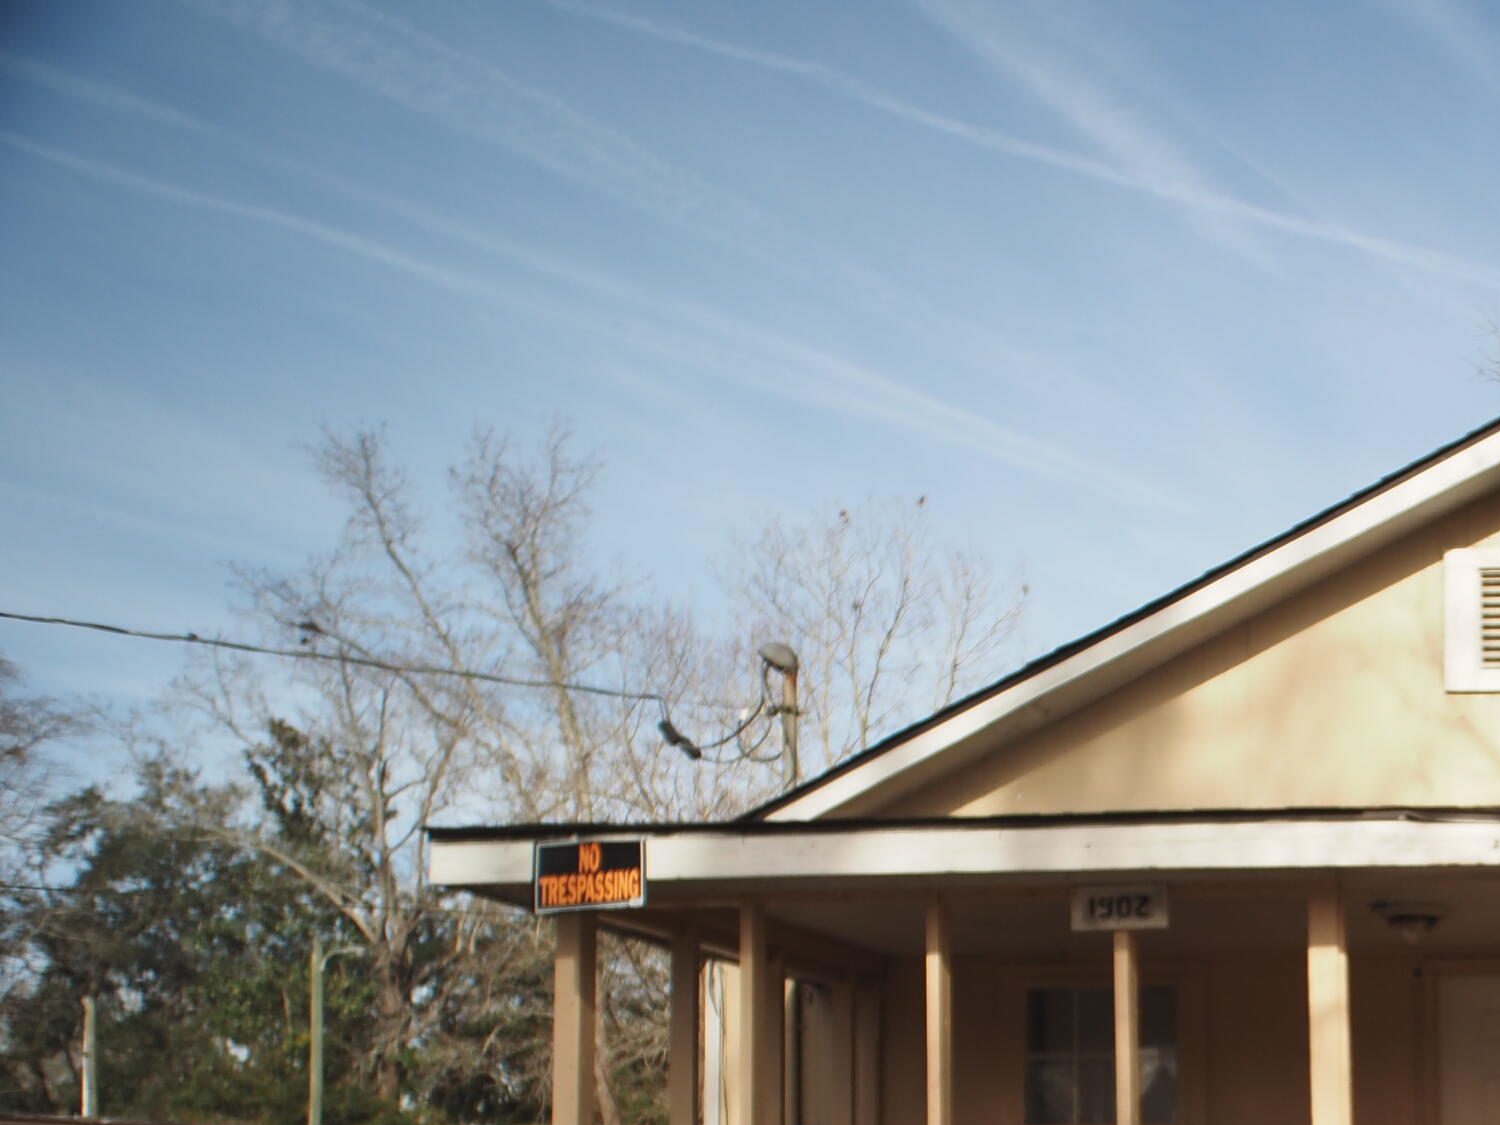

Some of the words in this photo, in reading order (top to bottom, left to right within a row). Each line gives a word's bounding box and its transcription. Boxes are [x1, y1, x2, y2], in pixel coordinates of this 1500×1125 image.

[578, 842, 601, 872] NO
[540, 868, 640, 907] TRESPASSING
[1088, 894, 1150, 919] 1902
